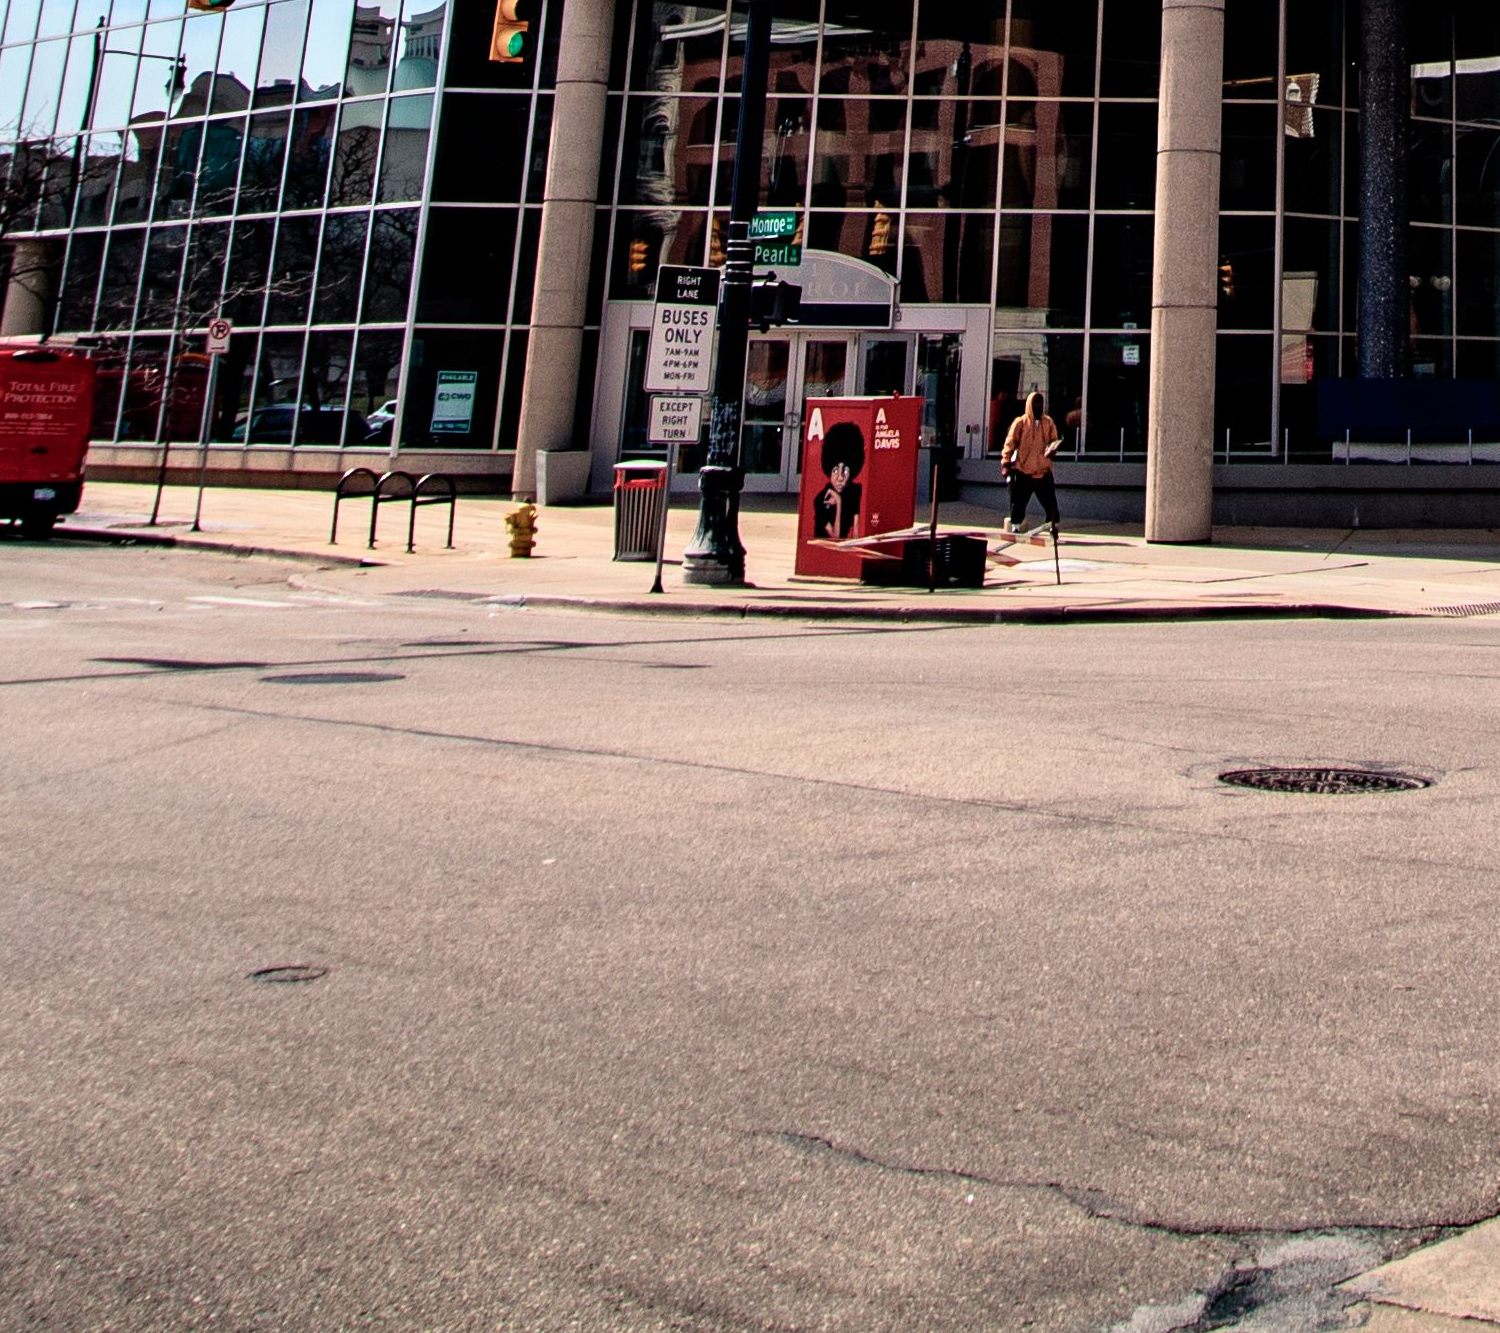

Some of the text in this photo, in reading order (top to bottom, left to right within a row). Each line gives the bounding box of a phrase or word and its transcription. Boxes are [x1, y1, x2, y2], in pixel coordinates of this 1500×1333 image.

[751, 217, 786, 233] Monroe
[754, 245, 789, 263] Pearl
[677, 275, 702, 286] RIGHT
[677, 289, 699, 300] LANE
[662, 309, 708, 326] BUSES
[665, 328, 702, 344] ONLY
[665, 347, 700, 356] 7AM-9AM
[663, 360, 699, 369] 4PM-6PM
[664, 372, 695, 380] MON-FRI
[10, 381, 77, 392] TOTAL FIRE
[4, 393, 77, 403] PROTECTION
[660, 402, 693, 412] EXCEPT
[662, 416, 688, 425] RIGHT
[876, 407, 887, 424] A
[807, 407, 824, 441] A
[663, 429, 686, 438] TURN
[875, 430, 900, 438] ANGELA
[874, 438, 900, 450] DAVIS
